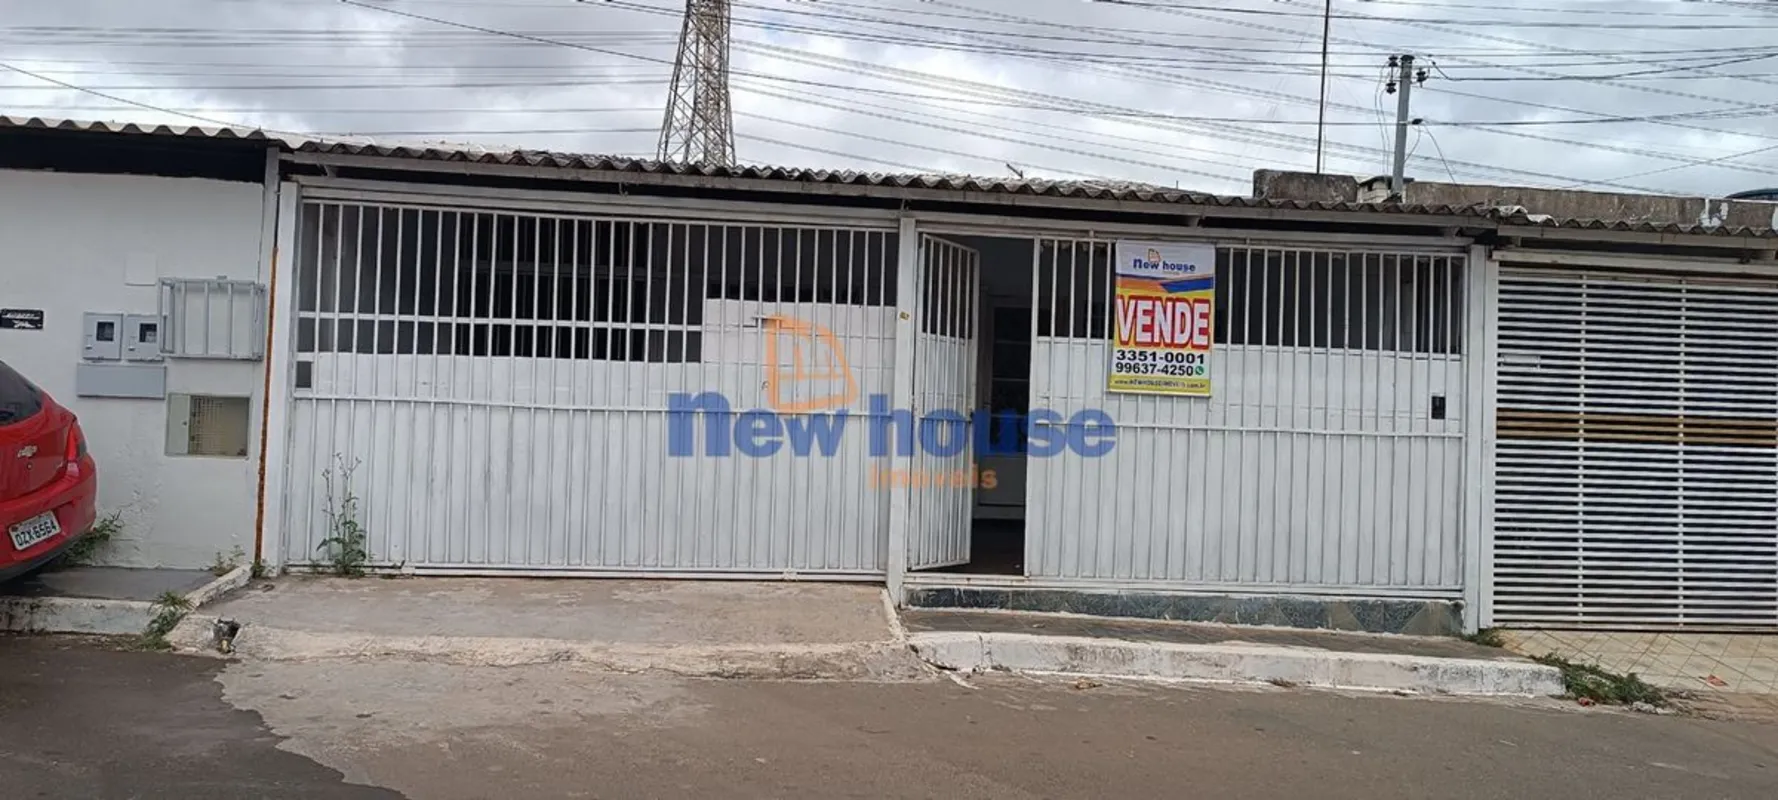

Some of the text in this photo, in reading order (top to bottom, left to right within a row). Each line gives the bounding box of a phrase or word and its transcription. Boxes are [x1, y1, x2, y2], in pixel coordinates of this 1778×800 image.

[1162, 260, 1197, 272] house
[1115, 297, 1211, 348] VENDE
[1116, 350, 1205, 364] 3351-0001
[1115, 362, 1194, 376] 99637-4250
